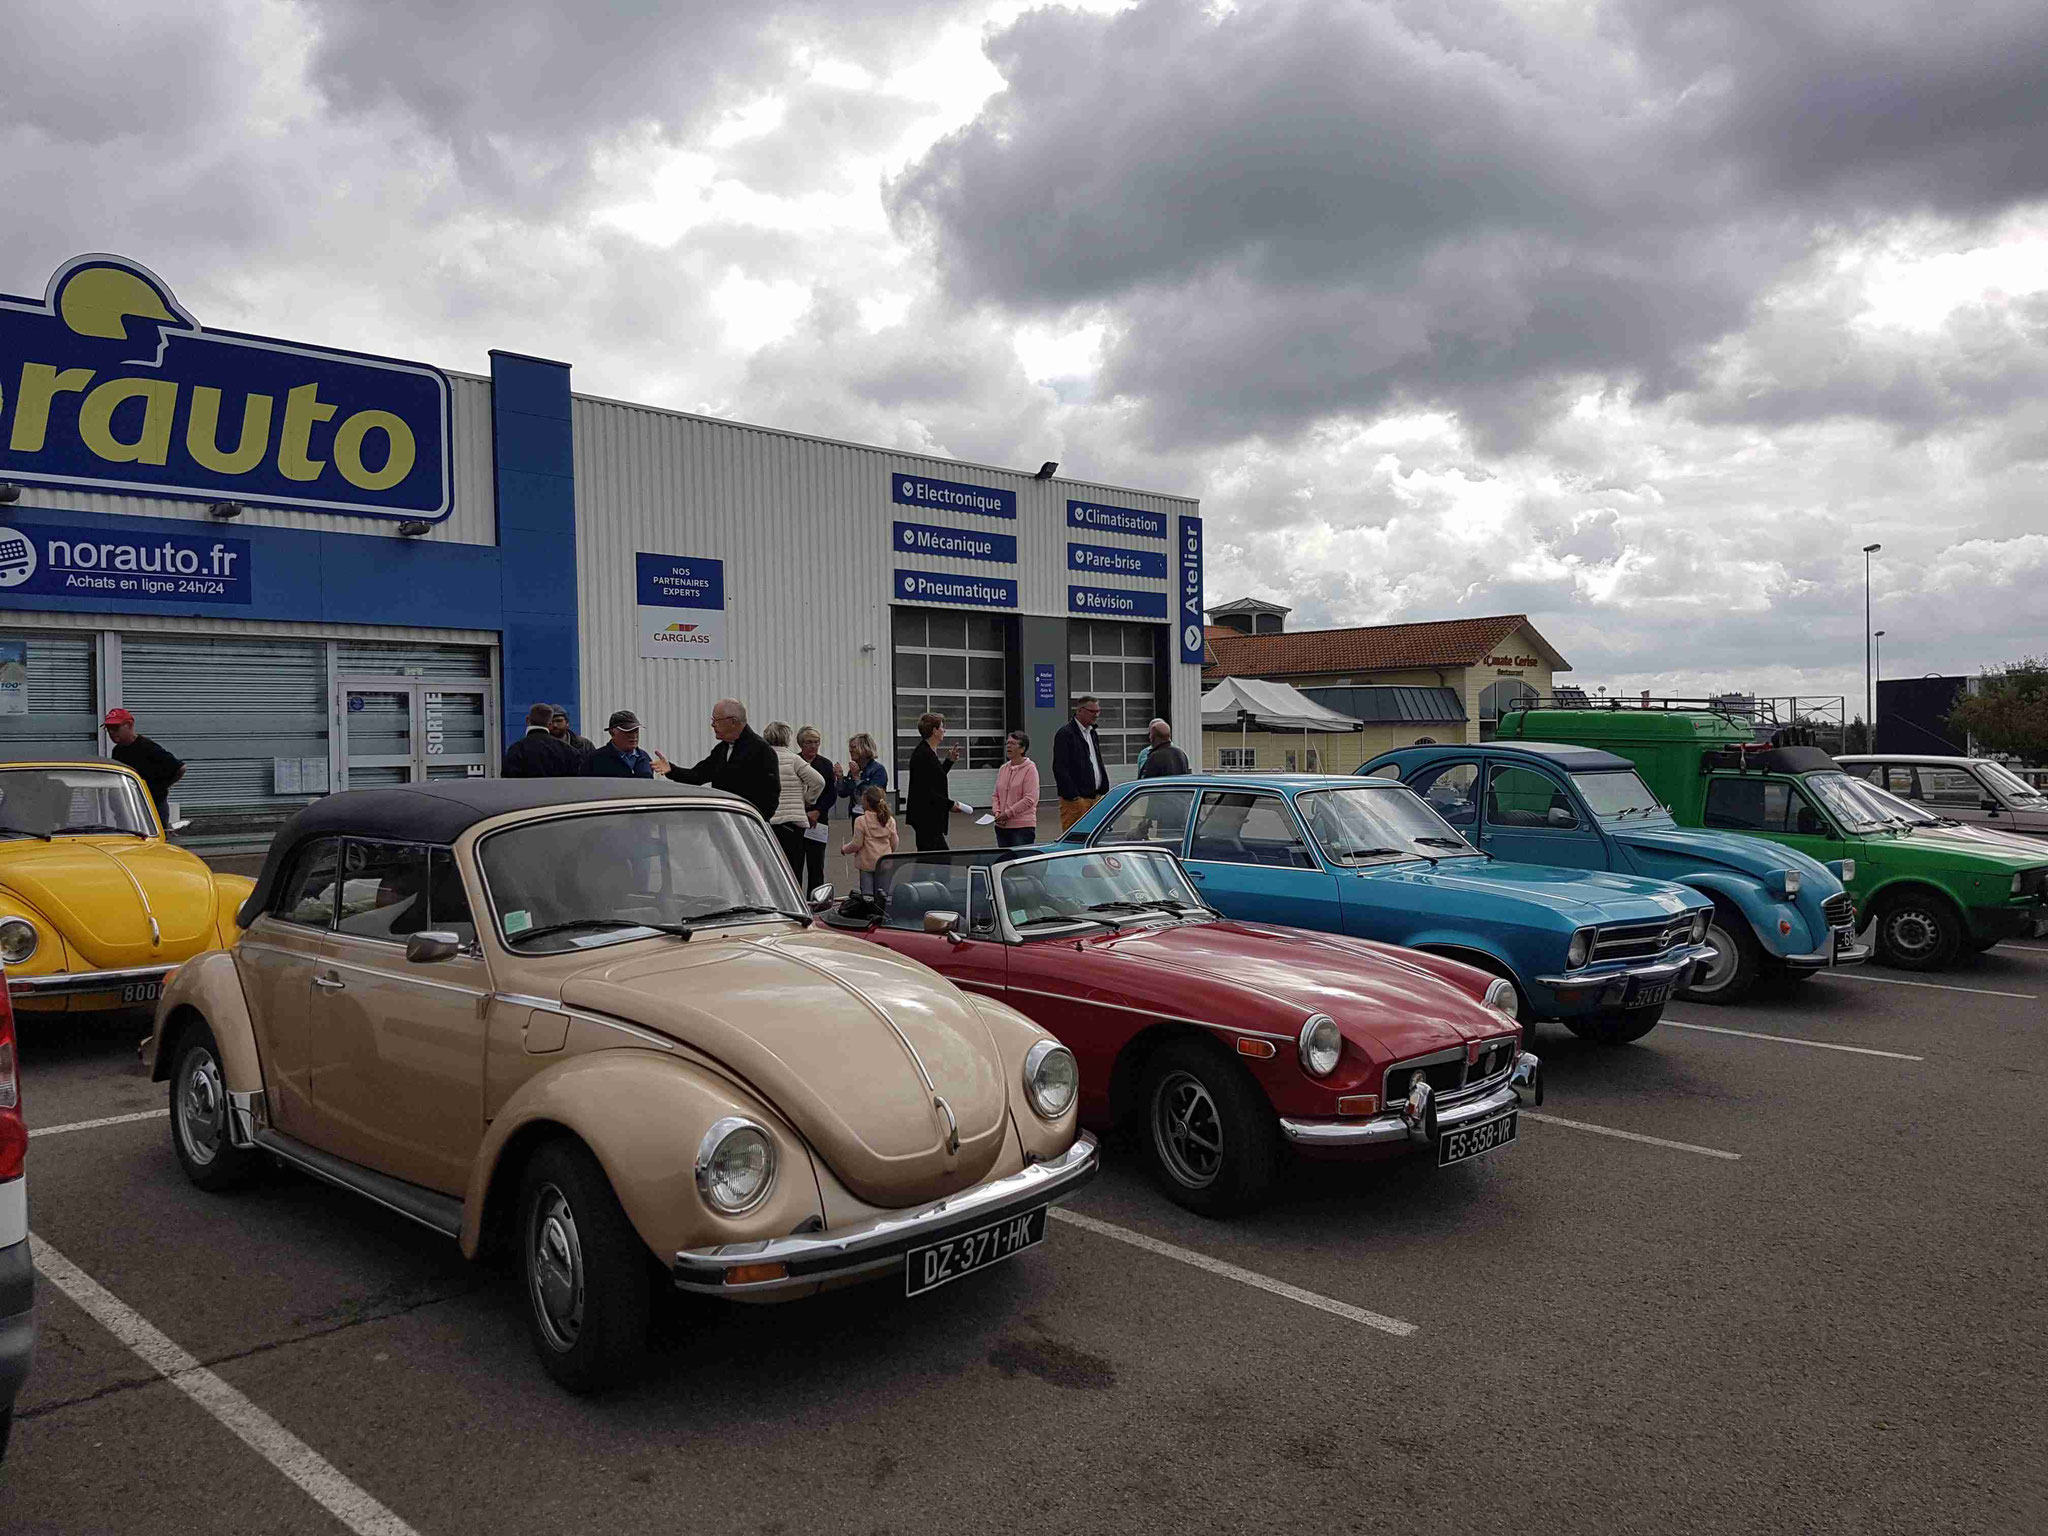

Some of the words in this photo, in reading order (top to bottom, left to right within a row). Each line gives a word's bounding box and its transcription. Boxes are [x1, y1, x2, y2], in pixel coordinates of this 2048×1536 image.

[0, 361, 416, 490] rauto
[916, 483, 1002, 512] Electronique
[1085, 508, 1158, 532] Climatisation
[917, 531, 992, 556] Mécanique
[48, 540, 237, 576] norauto.fr
[1086, 551, 1142, 570] Pare-brise
[653, 576, 709, 588] PARTENAIRES
[672, 567, 690, 576] NOS
[1183, 525, 1199, 616] Atelier
[65, 574, 116, 589] Achats
[120, 578, 138, 590] en
[141, 578, 175, 593] ligne
[178, 580, 225, 594] 24h/24
[663, 587, 700, 597] EXPERTS
[918, 578, 1007, 603] Pneumatique
[1087, 593, 1133, 610] Révision
[653, 632, 710, 644] CARGLASS
[1515, 654, 1538, 667] Cerise
[426, 692, 444, 755] SORTIE
[1448, 1117, 1511, 1160] ES-558-VR
[924, 1213, 1034, 1285] DZ-371-HK
